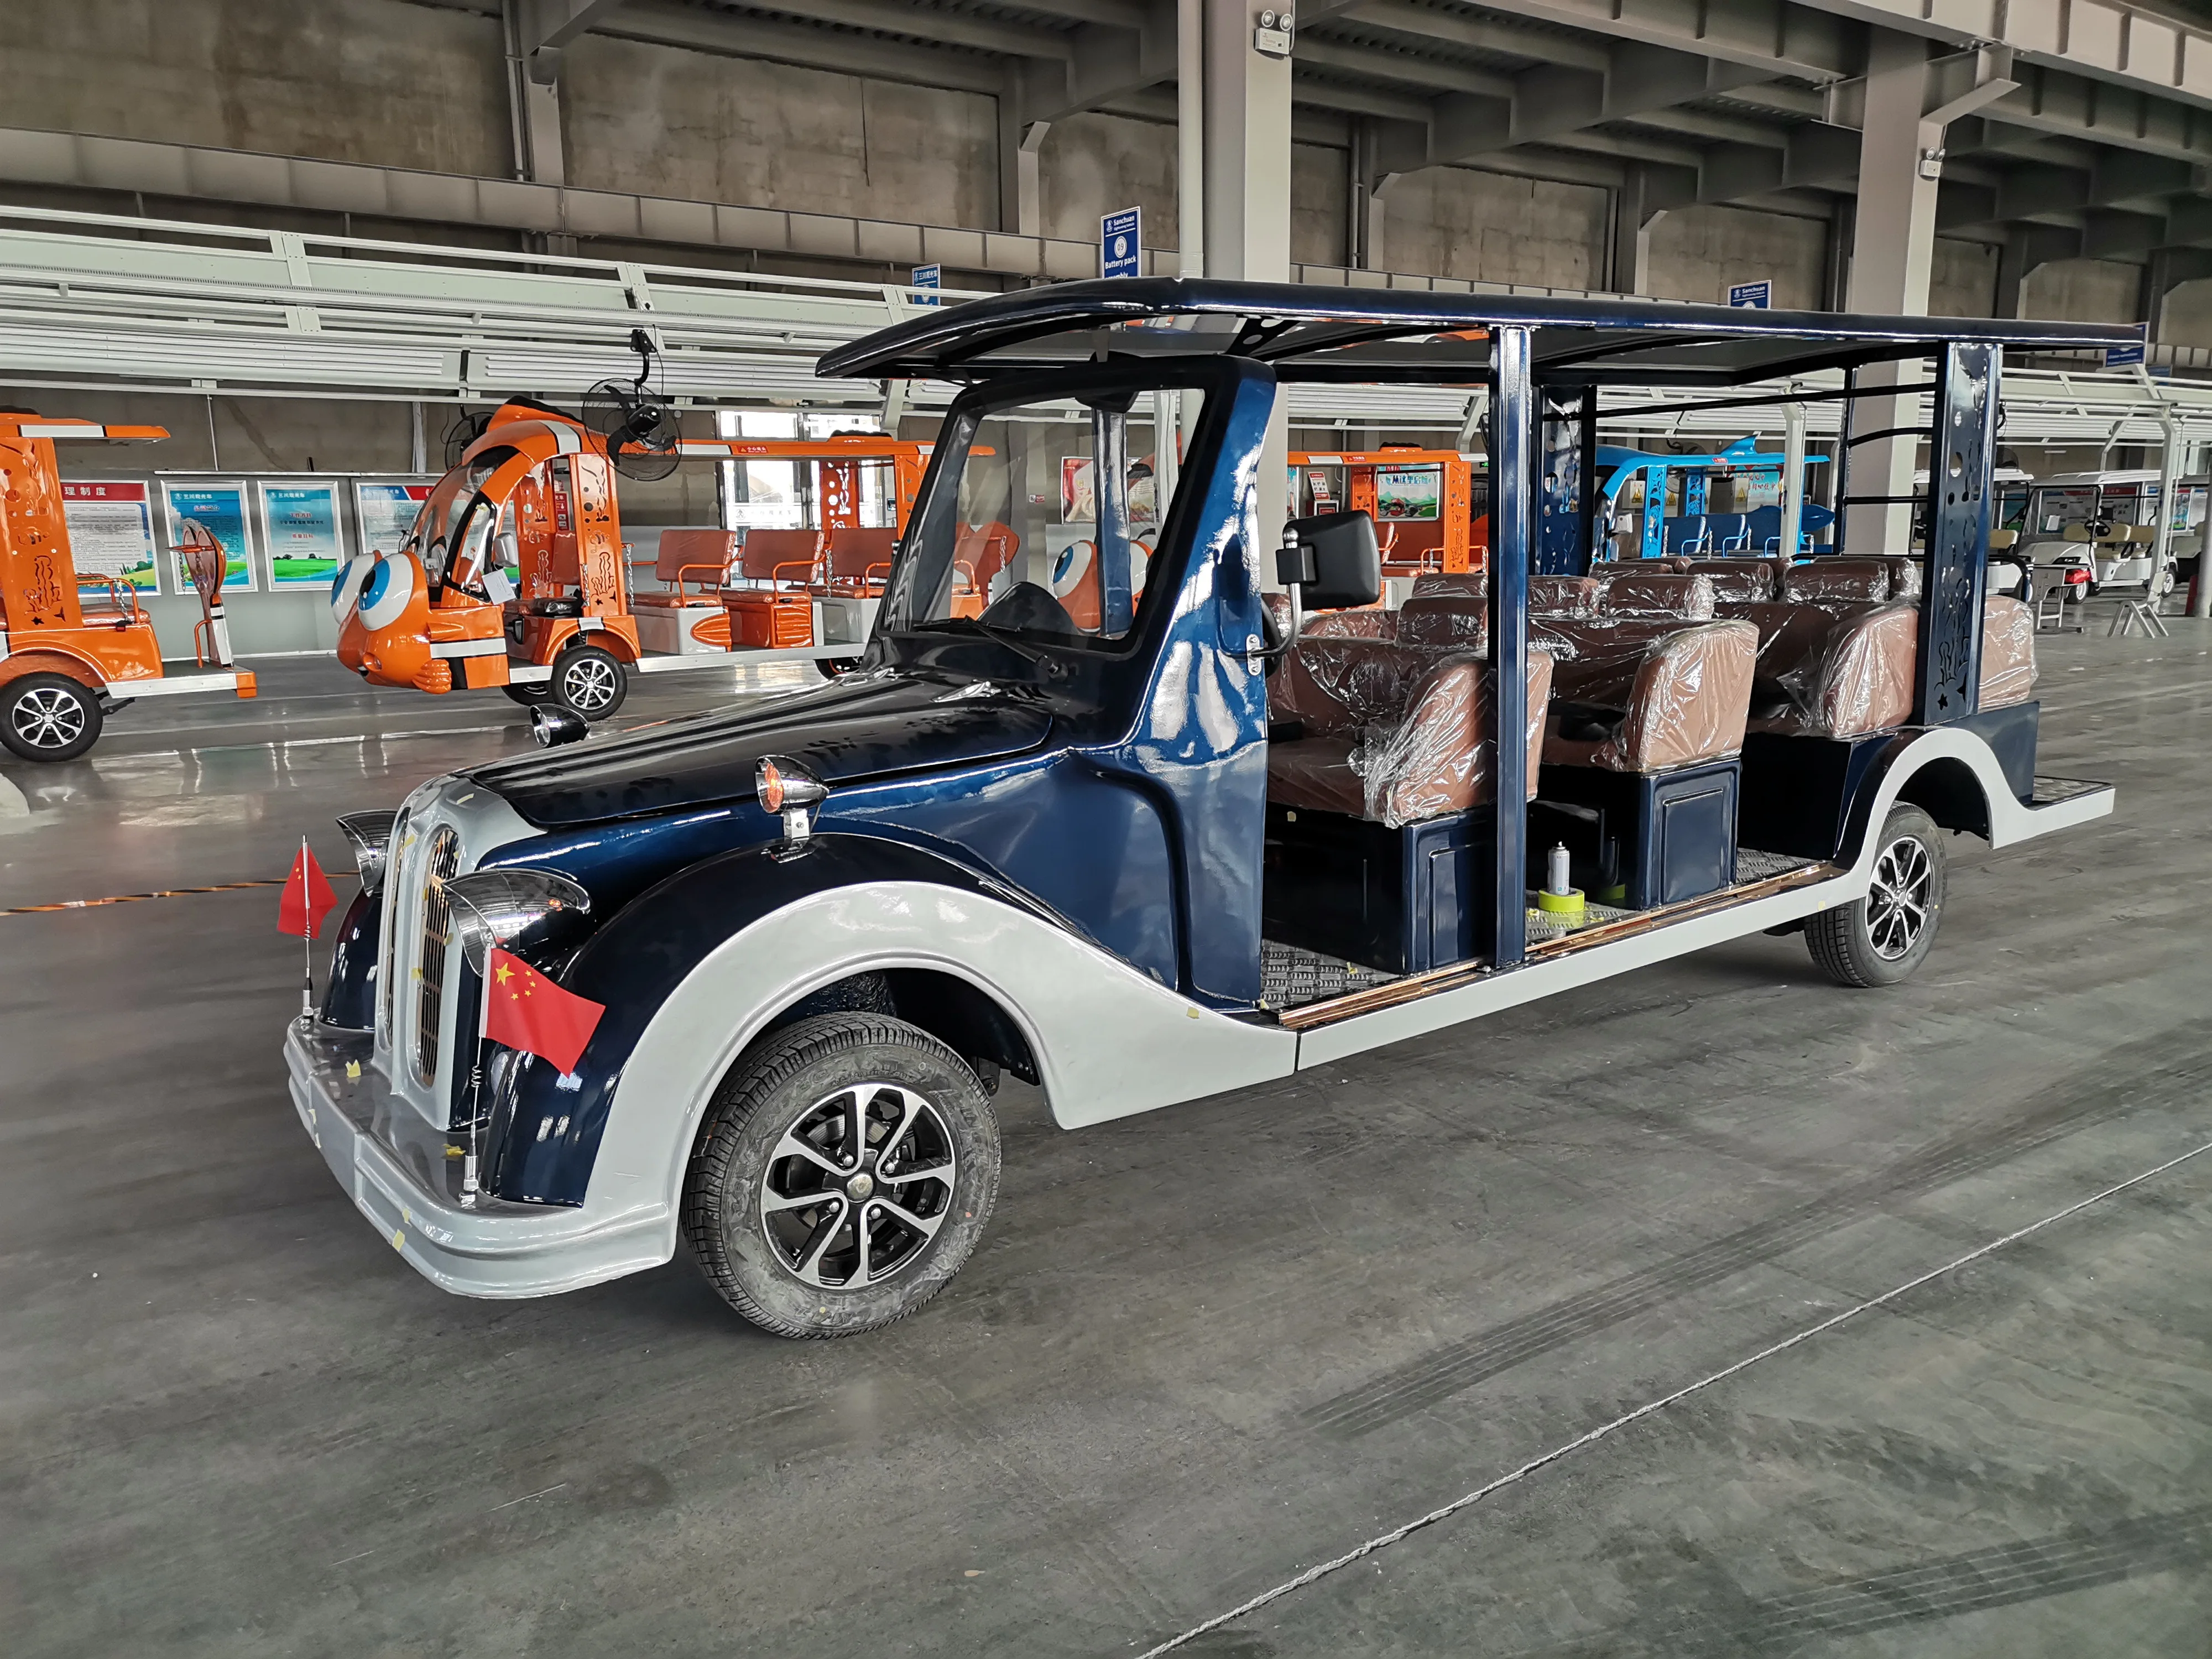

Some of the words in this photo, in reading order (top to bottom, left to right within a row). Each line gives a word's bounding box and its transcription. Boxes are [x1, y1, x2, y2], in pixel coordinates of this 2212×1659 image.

[1105, 260, 1123, 269] Battery
[1124, 255, 1136, 267] pack
[64, 487, 107, 496] 理制度
